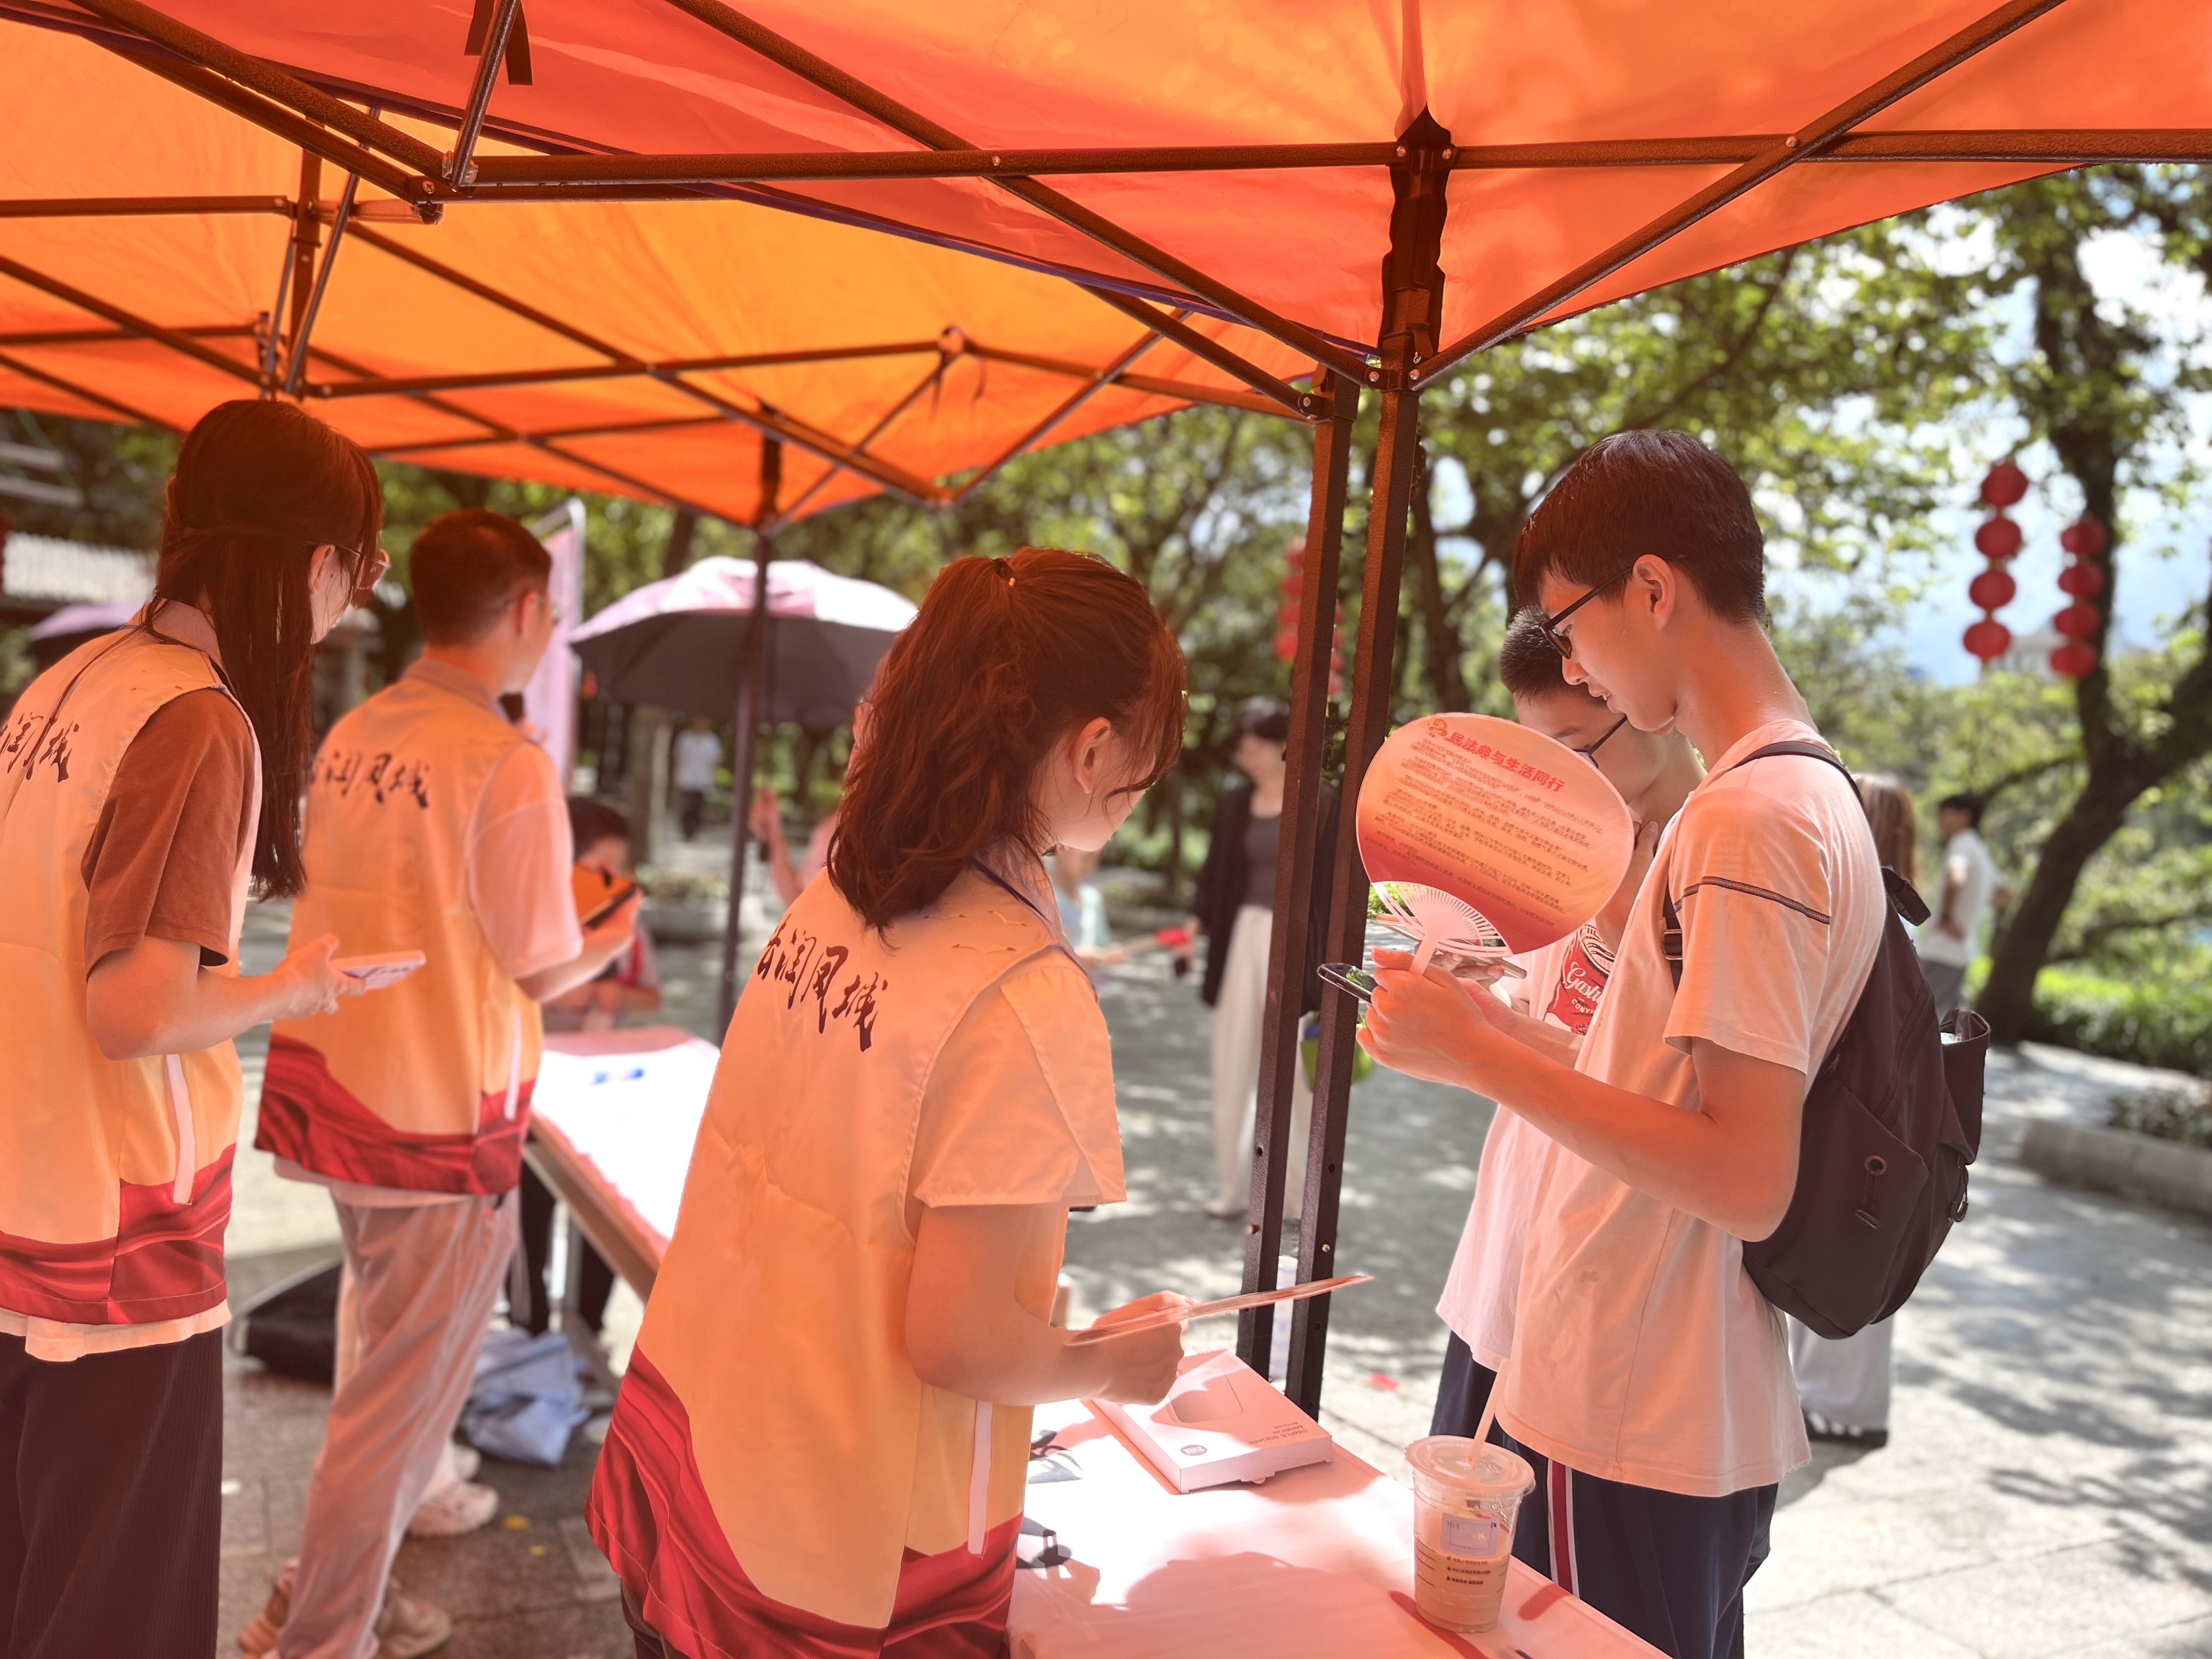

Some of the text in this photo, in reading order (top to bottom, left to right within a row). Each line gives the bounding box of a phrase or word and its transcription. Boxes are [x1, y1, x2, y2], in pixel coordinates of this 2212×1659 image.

[1446, 731, 1566, 792] 民法典与生活同行
